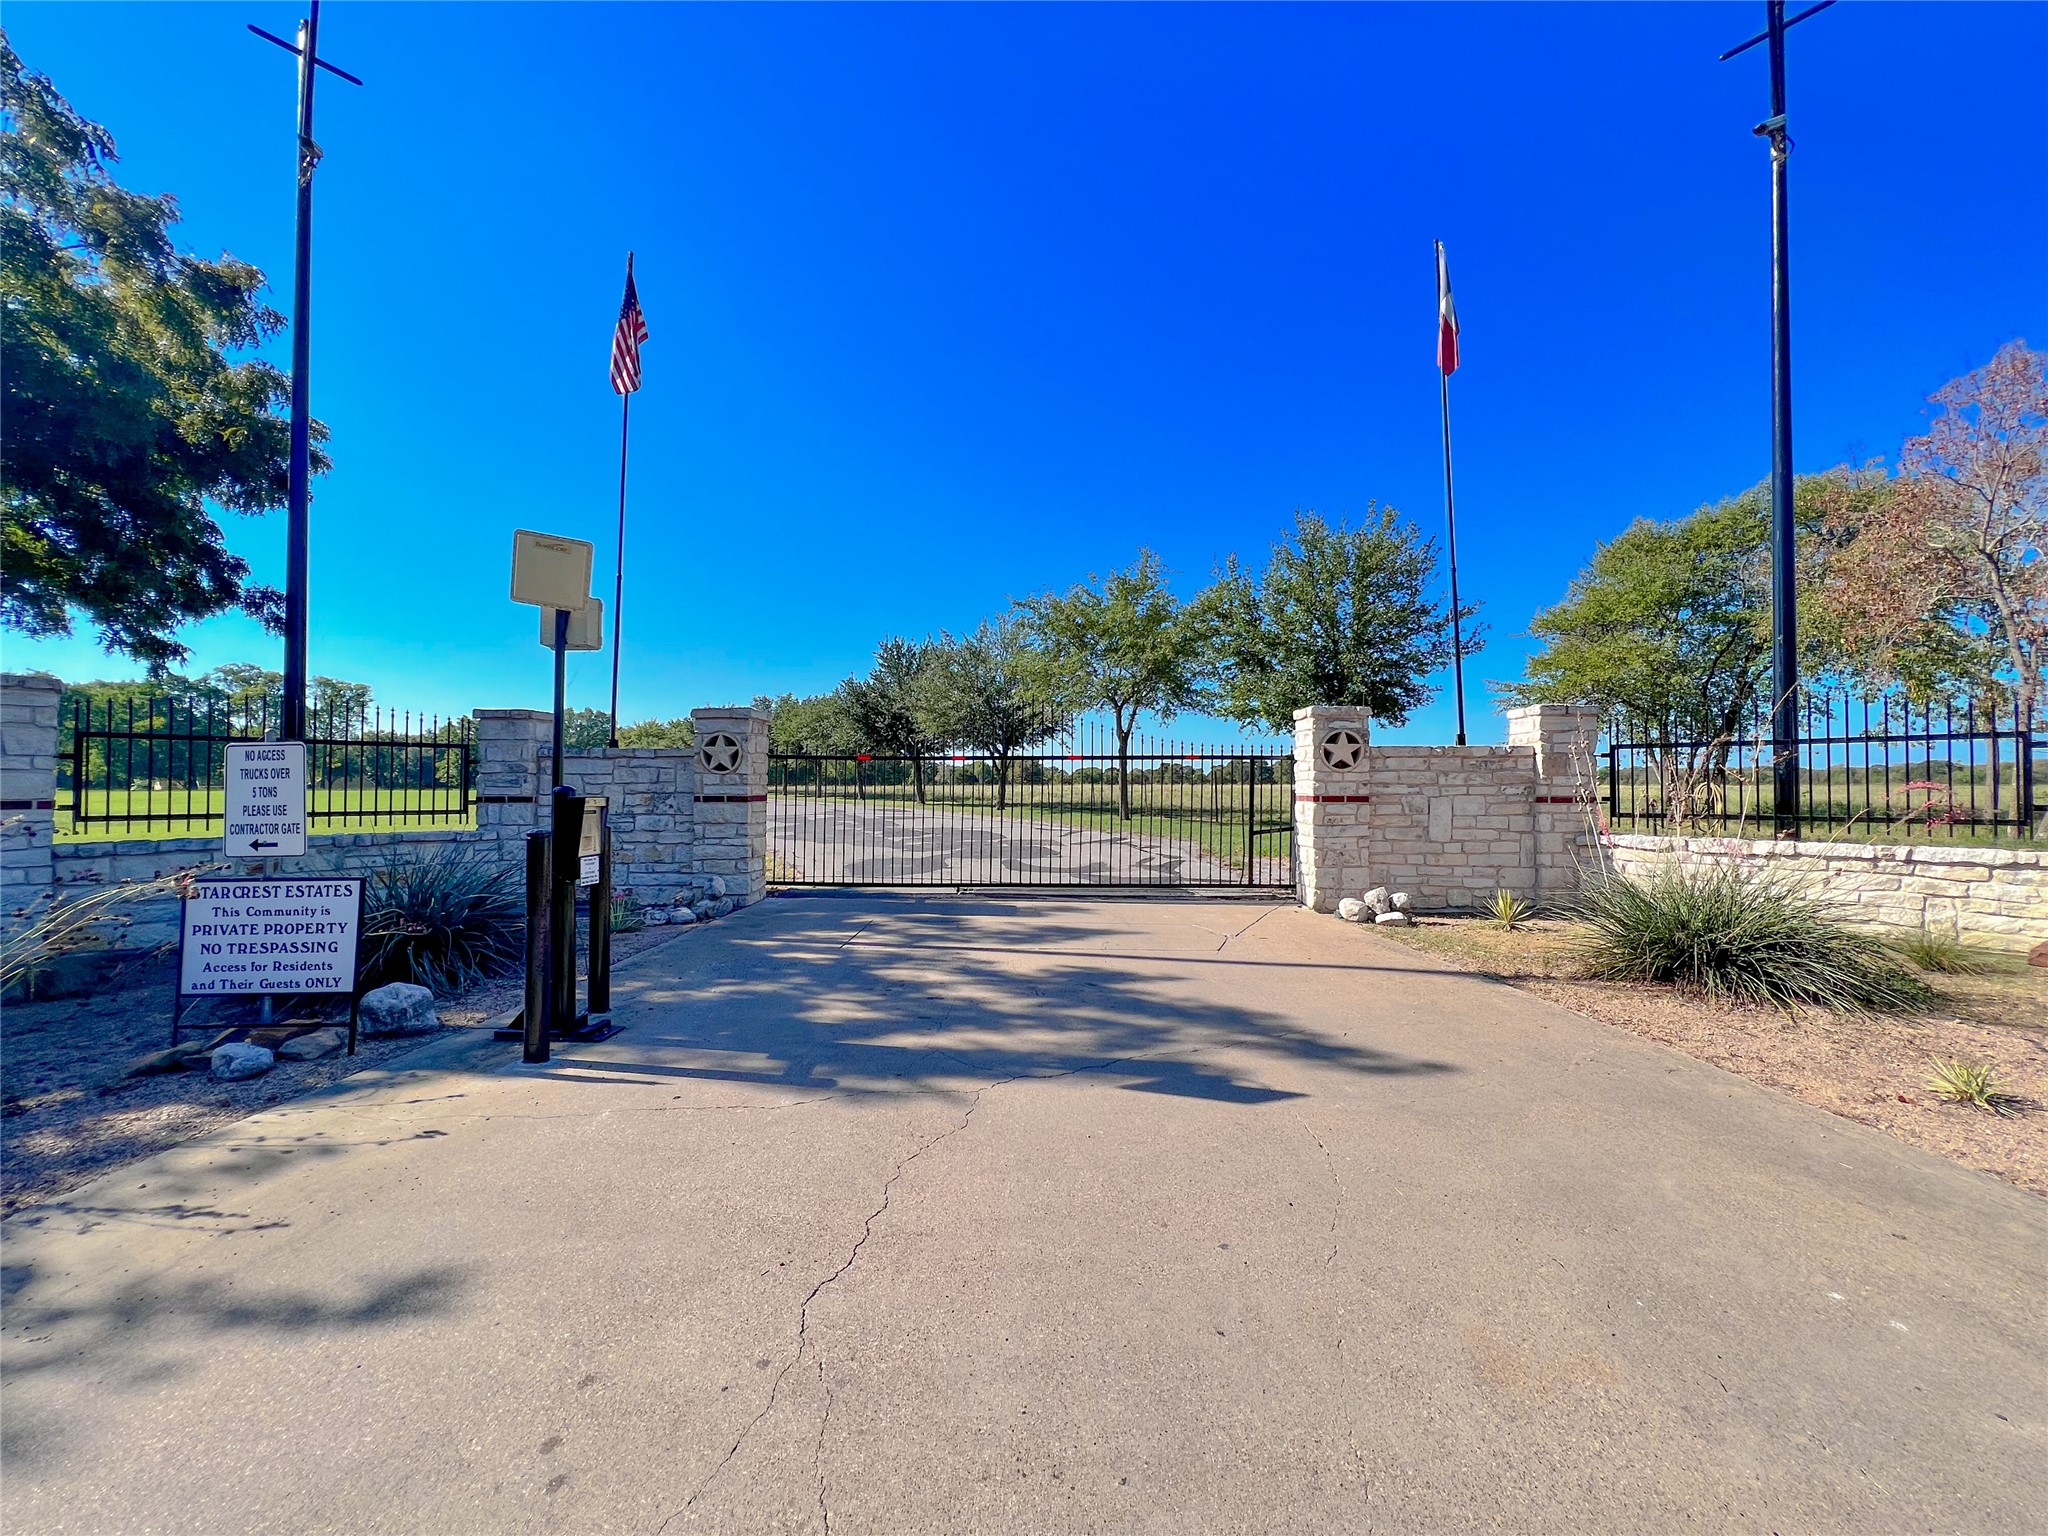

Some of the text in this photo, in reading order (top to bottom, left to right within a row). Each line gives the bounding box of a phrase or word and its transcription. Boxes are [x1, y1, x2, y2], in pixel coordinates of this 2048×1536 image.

[245, 750, 286, 761] NO ACCESS
[240, 768, 290, 780] TRUCKS OVER
[252, 786, 278, 798] 5 TONS
[242, 805, 288, 816] PLEASE USE
[230, 823, 300, 835] CONTRACTOR GATE
[197, 884, 353, 899] TARCREST ESTATES
[212, 906, 331, 918] This Community is
[192, 922, 348, 936] PRIVATE PROPERTY
[200, 941, 338, 955] NO TRESPASSING
[202, 960, 333, 973] Access for Residents
[191, 977, 342, 990] and Their Guests ONLY
